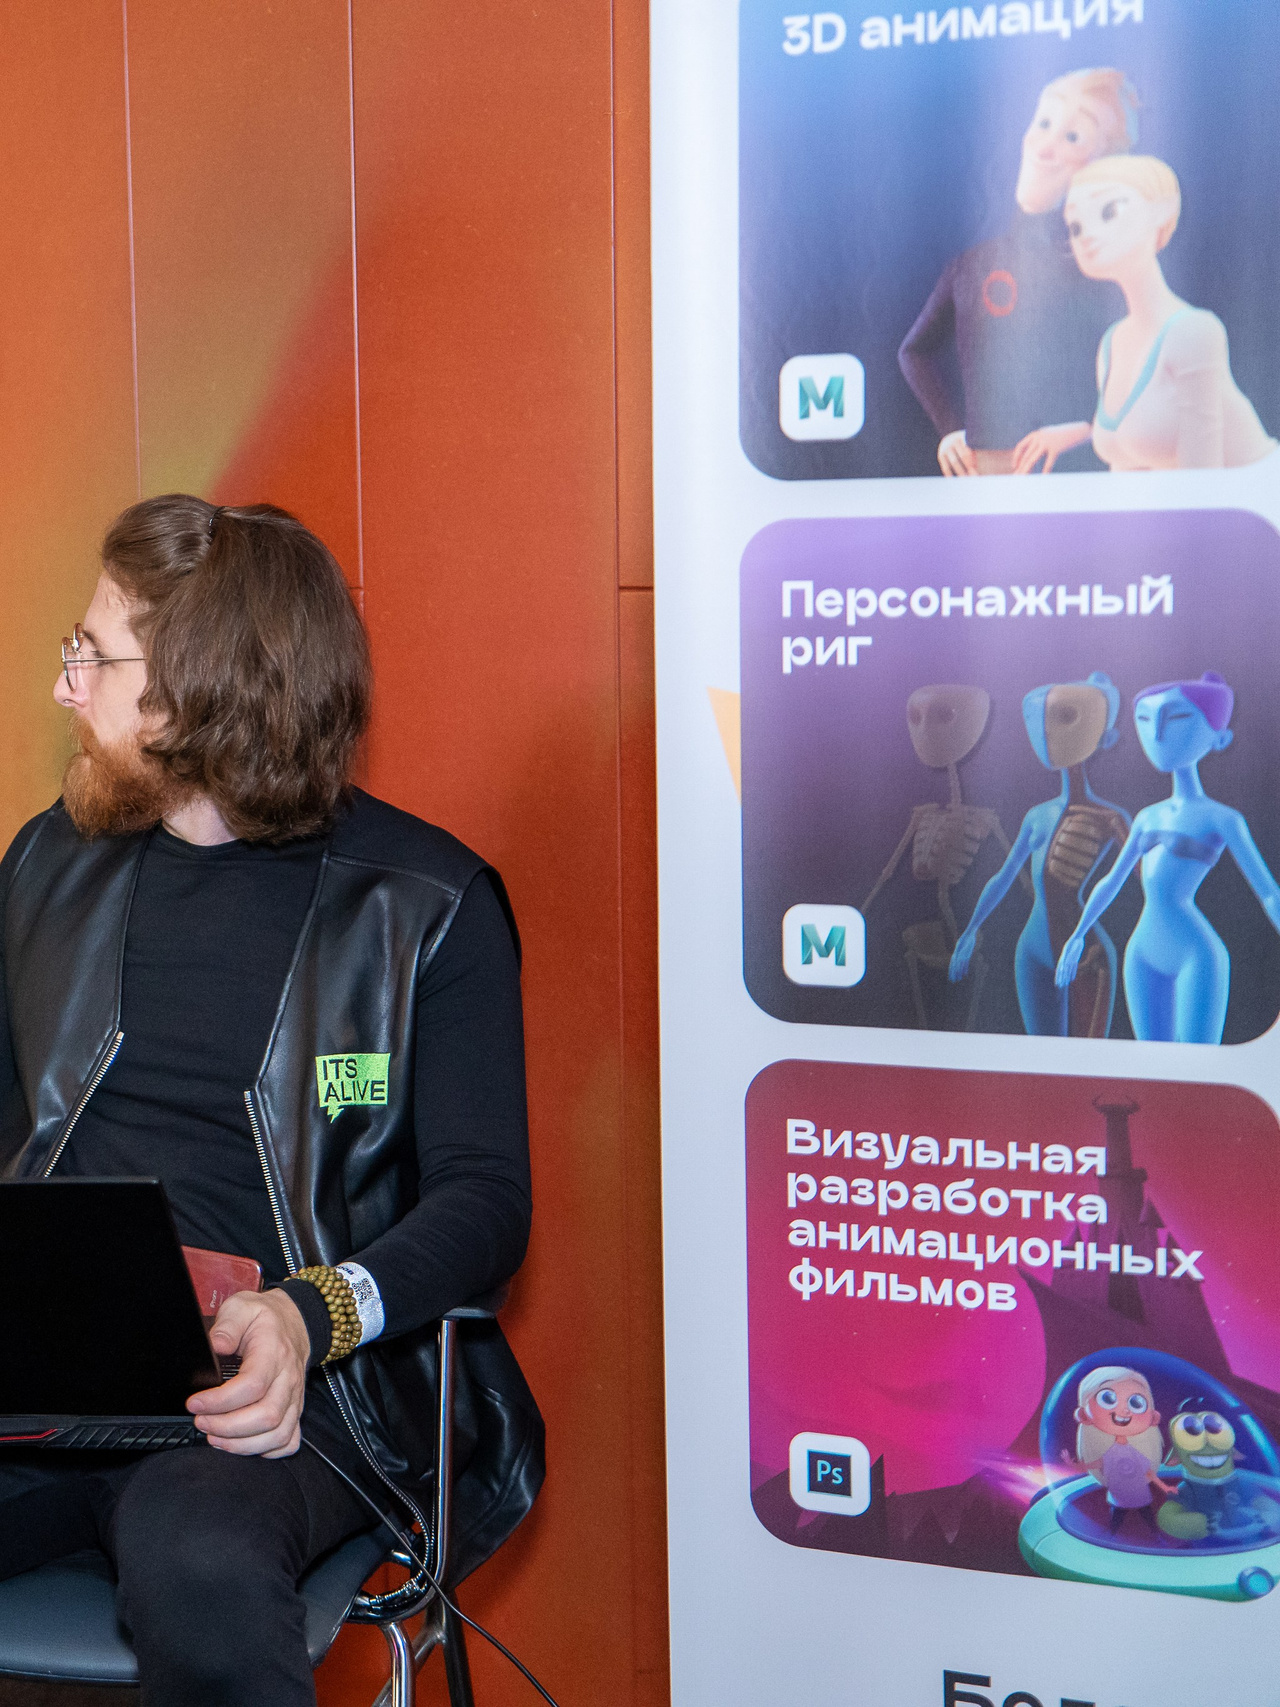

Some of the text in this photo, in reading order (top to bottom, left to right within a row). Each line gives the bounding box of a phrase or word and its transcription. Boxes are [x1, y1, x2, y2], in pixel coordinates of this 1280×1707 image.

[781, 0, 1145, 55] 3D анимация
[781, 574, 1174, 626] Персонажный
[781, 635, 873, 674] риг
[322, 1058, 358, 1080] ITS
[323, 1080, 386, 1103] ALIVE
[786, 1118, 1108, 1176] Визуальная
[787, 1171, 1108, 1224] разработка
[788, 1218, 1205, 1281] анимационных
[788, 1256, 1018, 1312] фильмов
[817, 1459, 844, 1485] Ps
